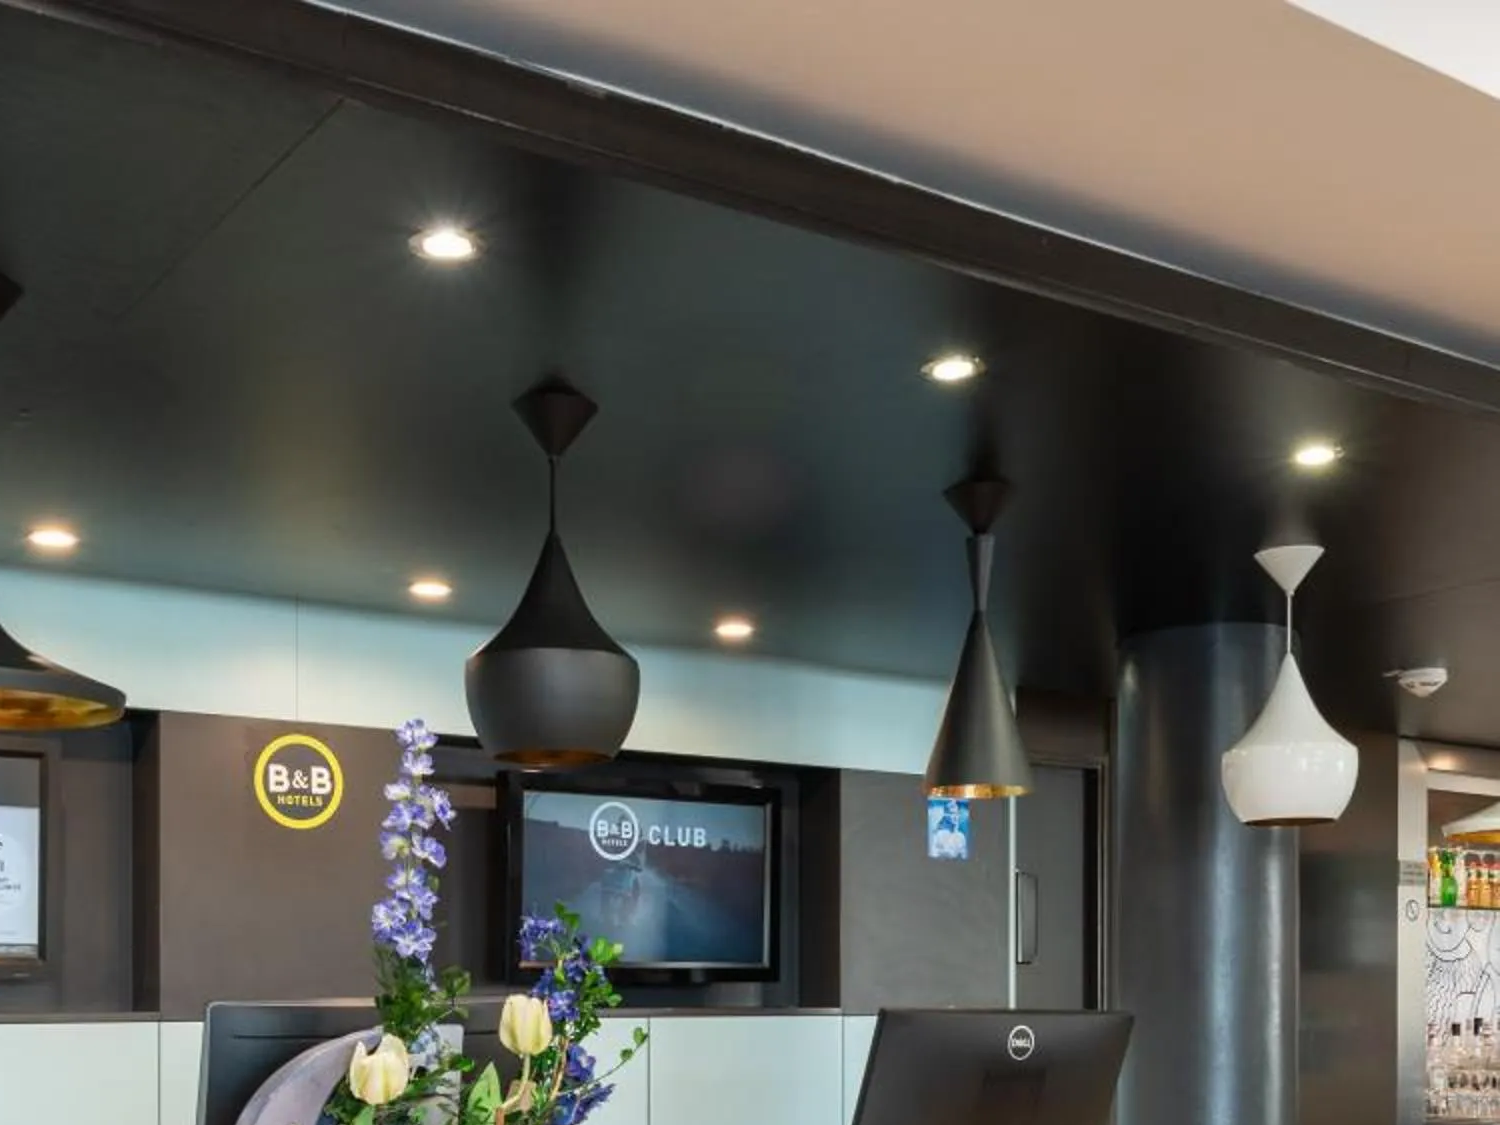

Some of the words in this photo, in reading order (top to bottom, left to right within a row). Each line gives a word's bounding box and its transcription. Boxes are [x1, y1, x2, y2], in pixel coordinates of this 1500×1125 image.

[268, 763, 333, 795] B&B
[277, 794, 323, 807] HOTELS
[597, 820, 633, 839] B&B
[648, 825, 706, 848] CLUB
